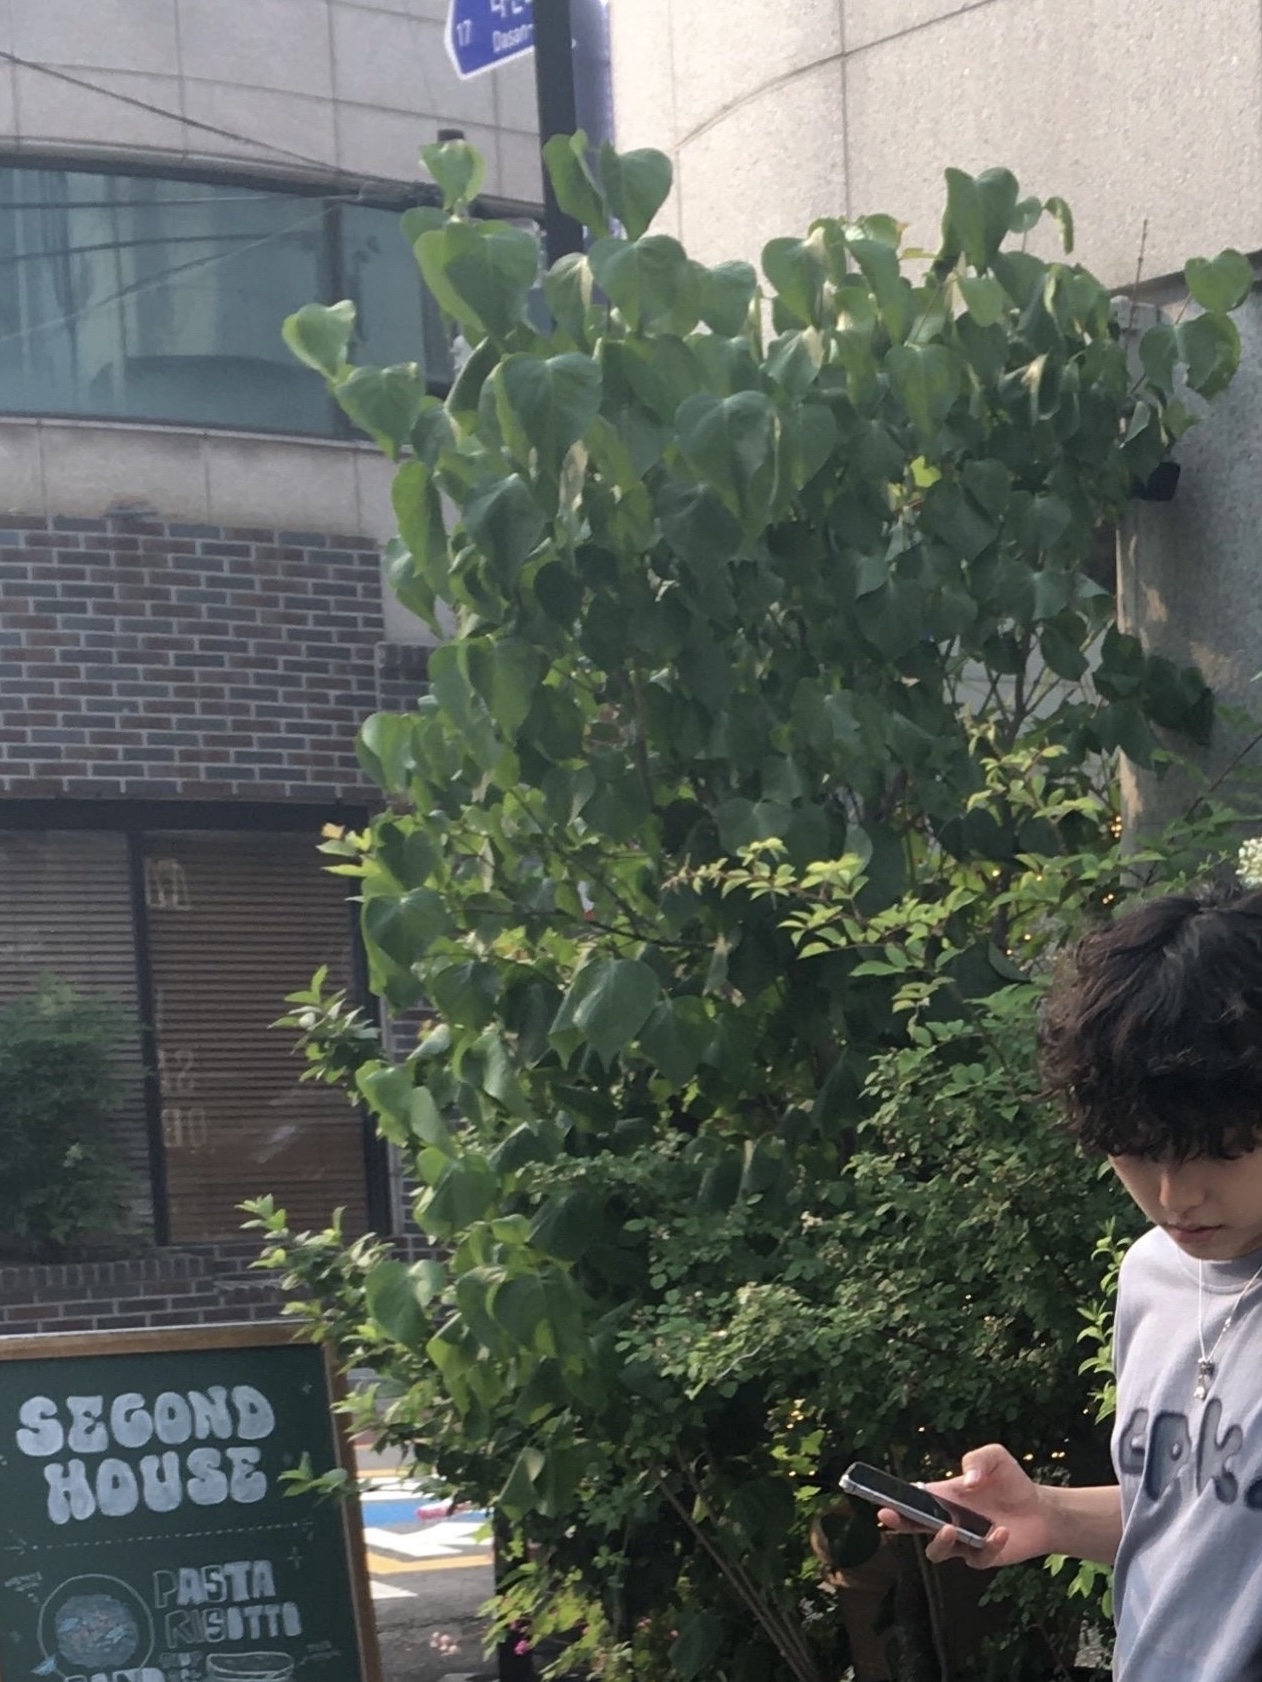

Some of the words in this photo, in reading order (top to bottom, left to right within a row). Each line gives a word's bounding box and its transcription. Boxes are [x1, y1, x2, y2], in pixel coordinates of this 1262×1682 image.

[456, 19, 472, 47] 17
[16, 1385, 275, 1456] SECOND
[44, 1447, 267, 1525] HOUSE
[152, 1560, 276, 1608] PASTA
[164, 1601, 302, 1649] RISOTTO
